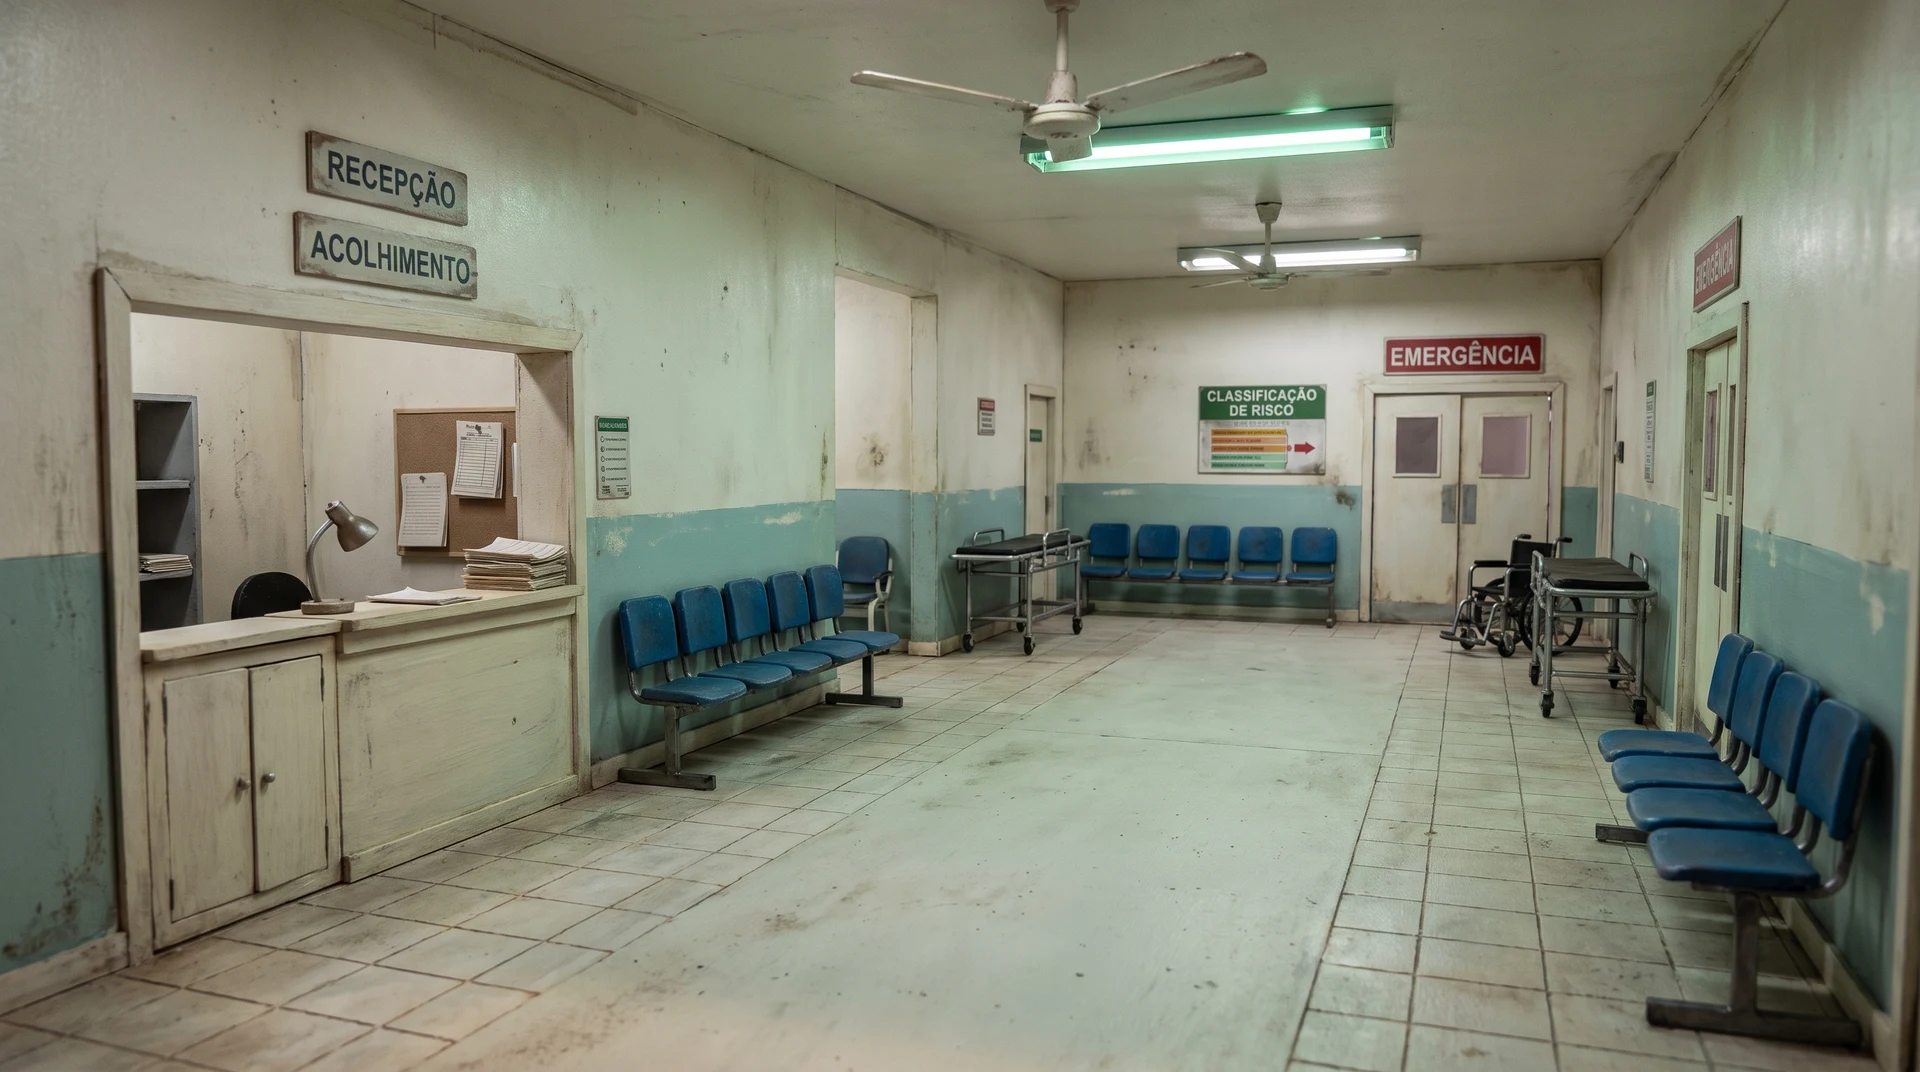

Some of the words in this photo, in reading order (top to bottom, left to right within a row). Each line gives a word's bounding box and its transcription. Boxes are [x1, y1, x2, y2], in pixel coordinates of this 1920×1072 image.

[328, 150, 456, 209] RECEPÇÃO
[310, 230, 470, 285] ACOLHIMENTO
[1391, 340, 1536, 367] EMERGÊNCIA
[1207, 386, 1317, 404] CLASSIFICAÇÃO
[1229, 404, 1248, 417] DE
[1251, 404, 1294, 417] RISCO
